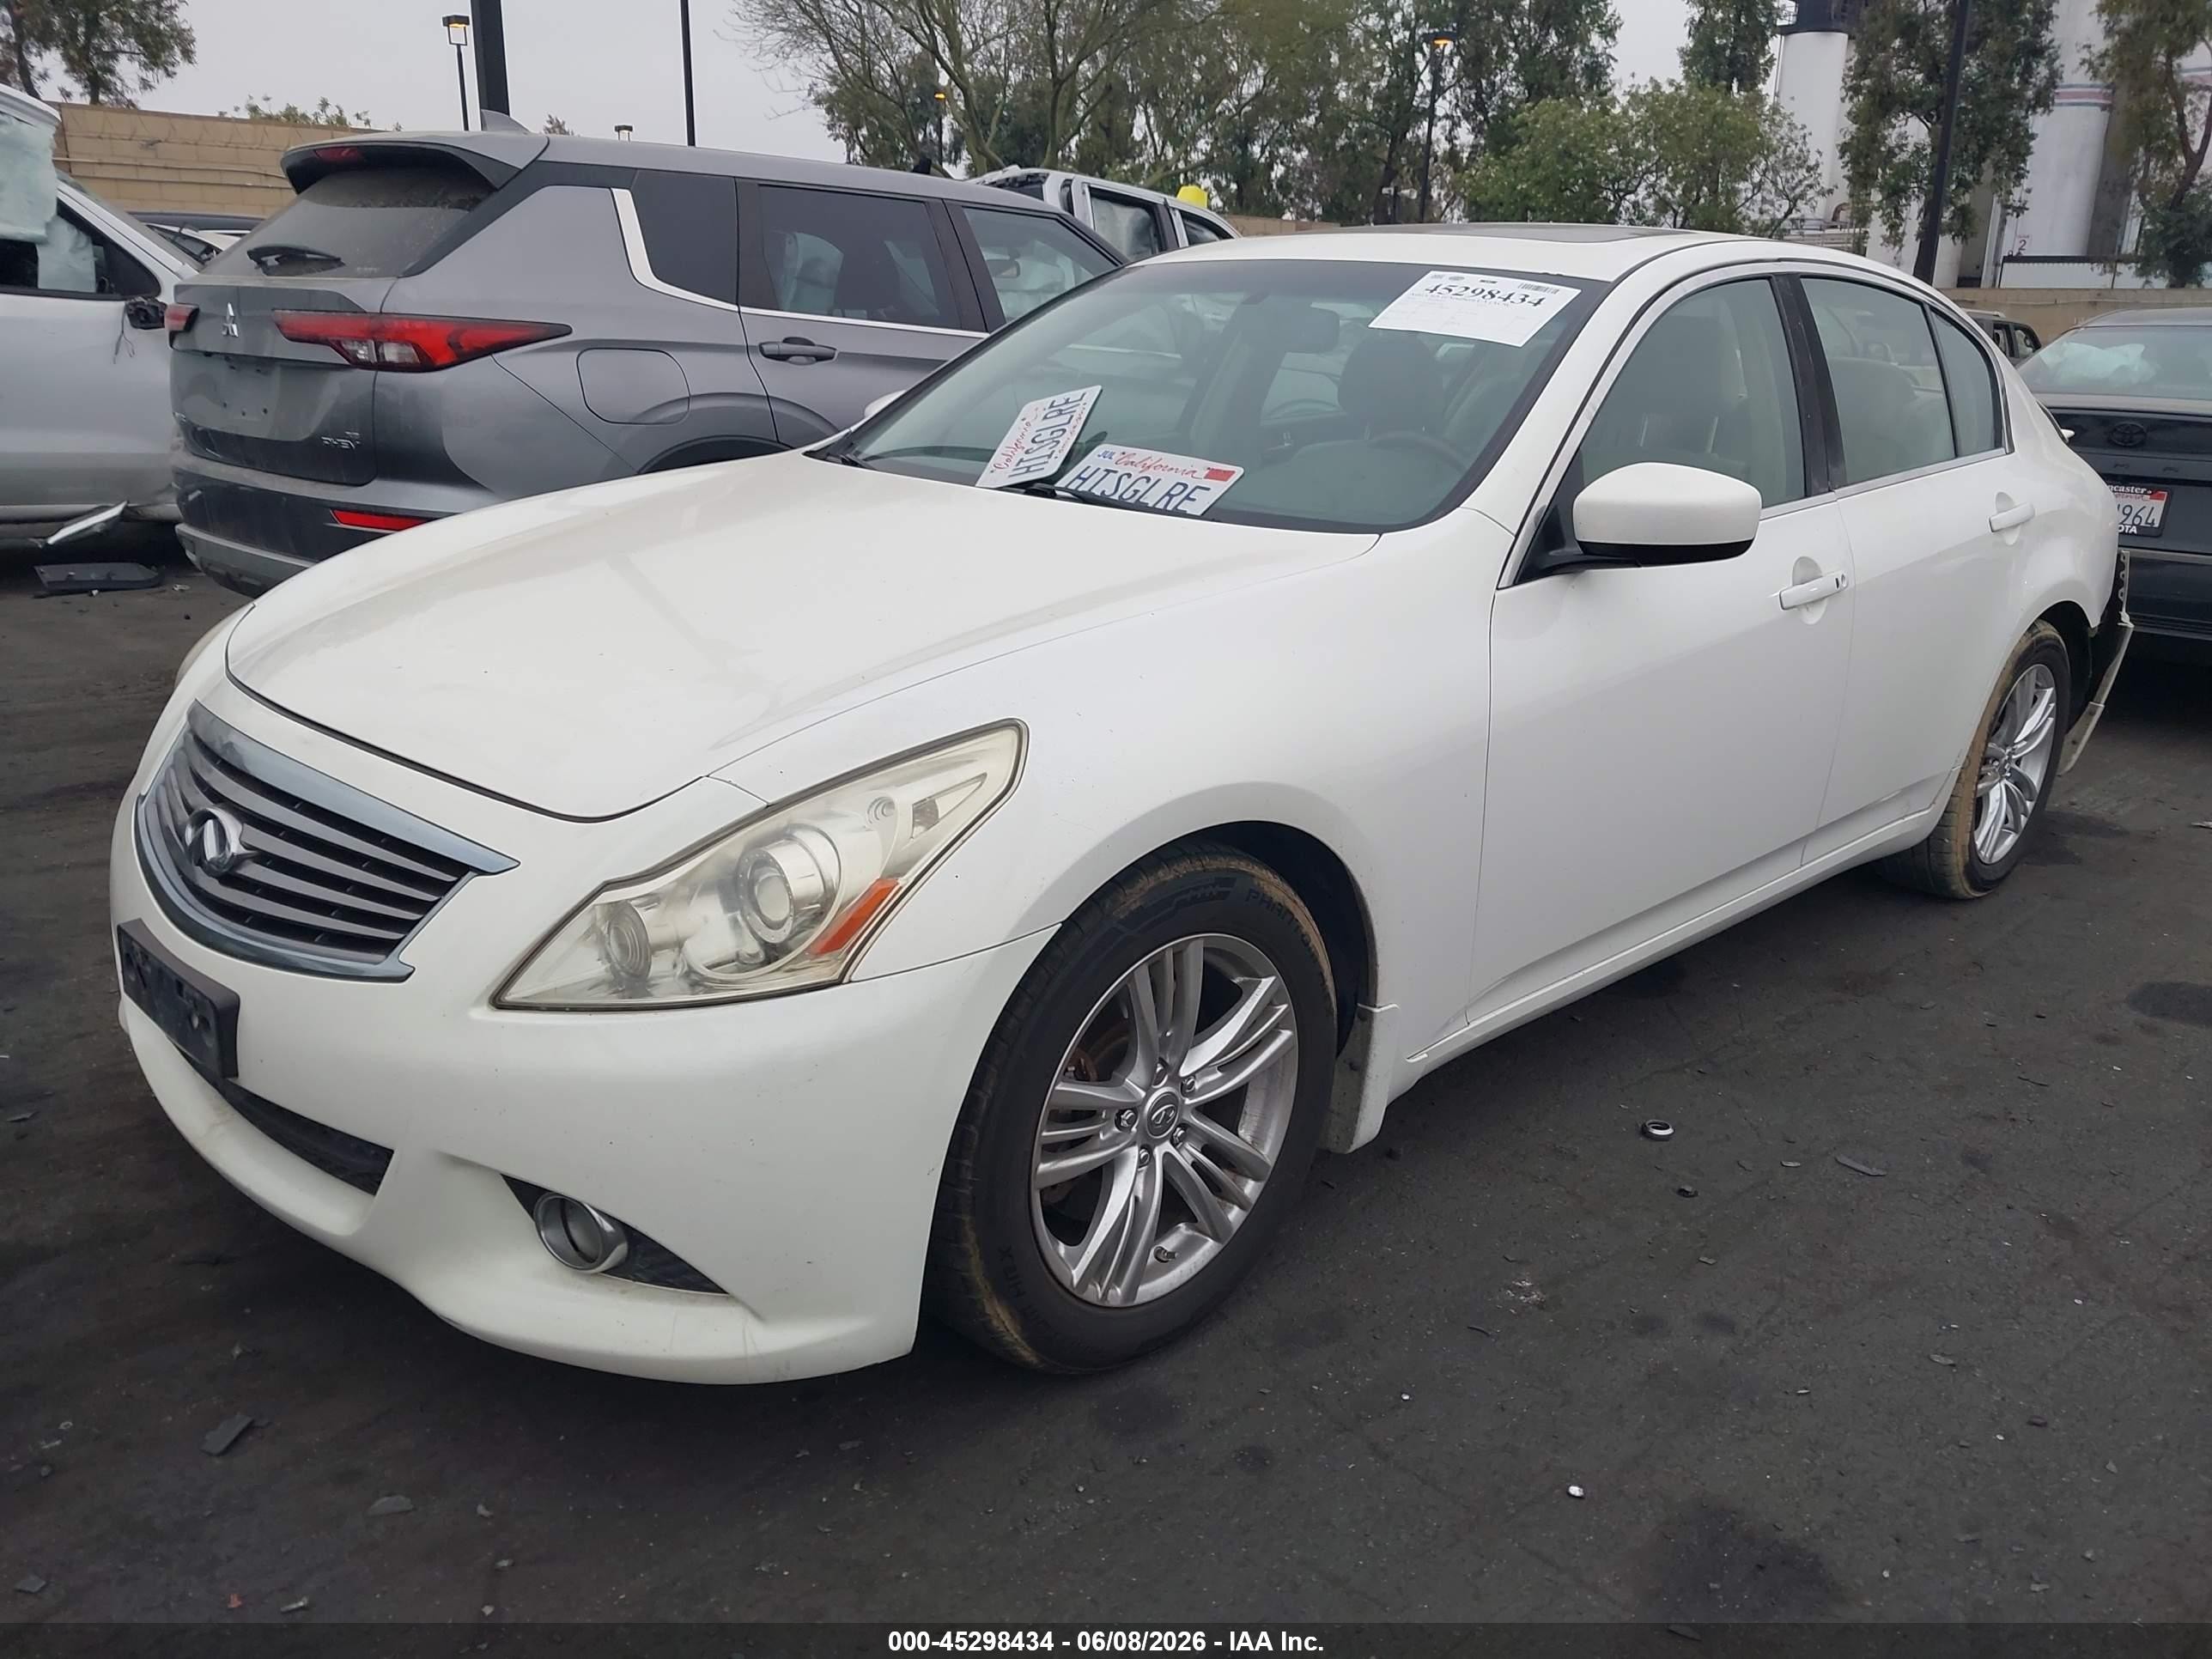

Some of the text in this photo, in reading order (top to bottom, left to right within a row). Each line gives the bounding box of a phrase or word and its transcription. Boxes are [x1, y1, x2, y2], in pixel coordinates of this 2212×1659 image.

[1425, 283, 1547, 307] 45298434
[1097, 449, 1116, 461] JUL
[1115, 452, 1204, 481] California
[2108, 483, 2148, 495] ncaster
[2117, 503, 2155, 526] 964
